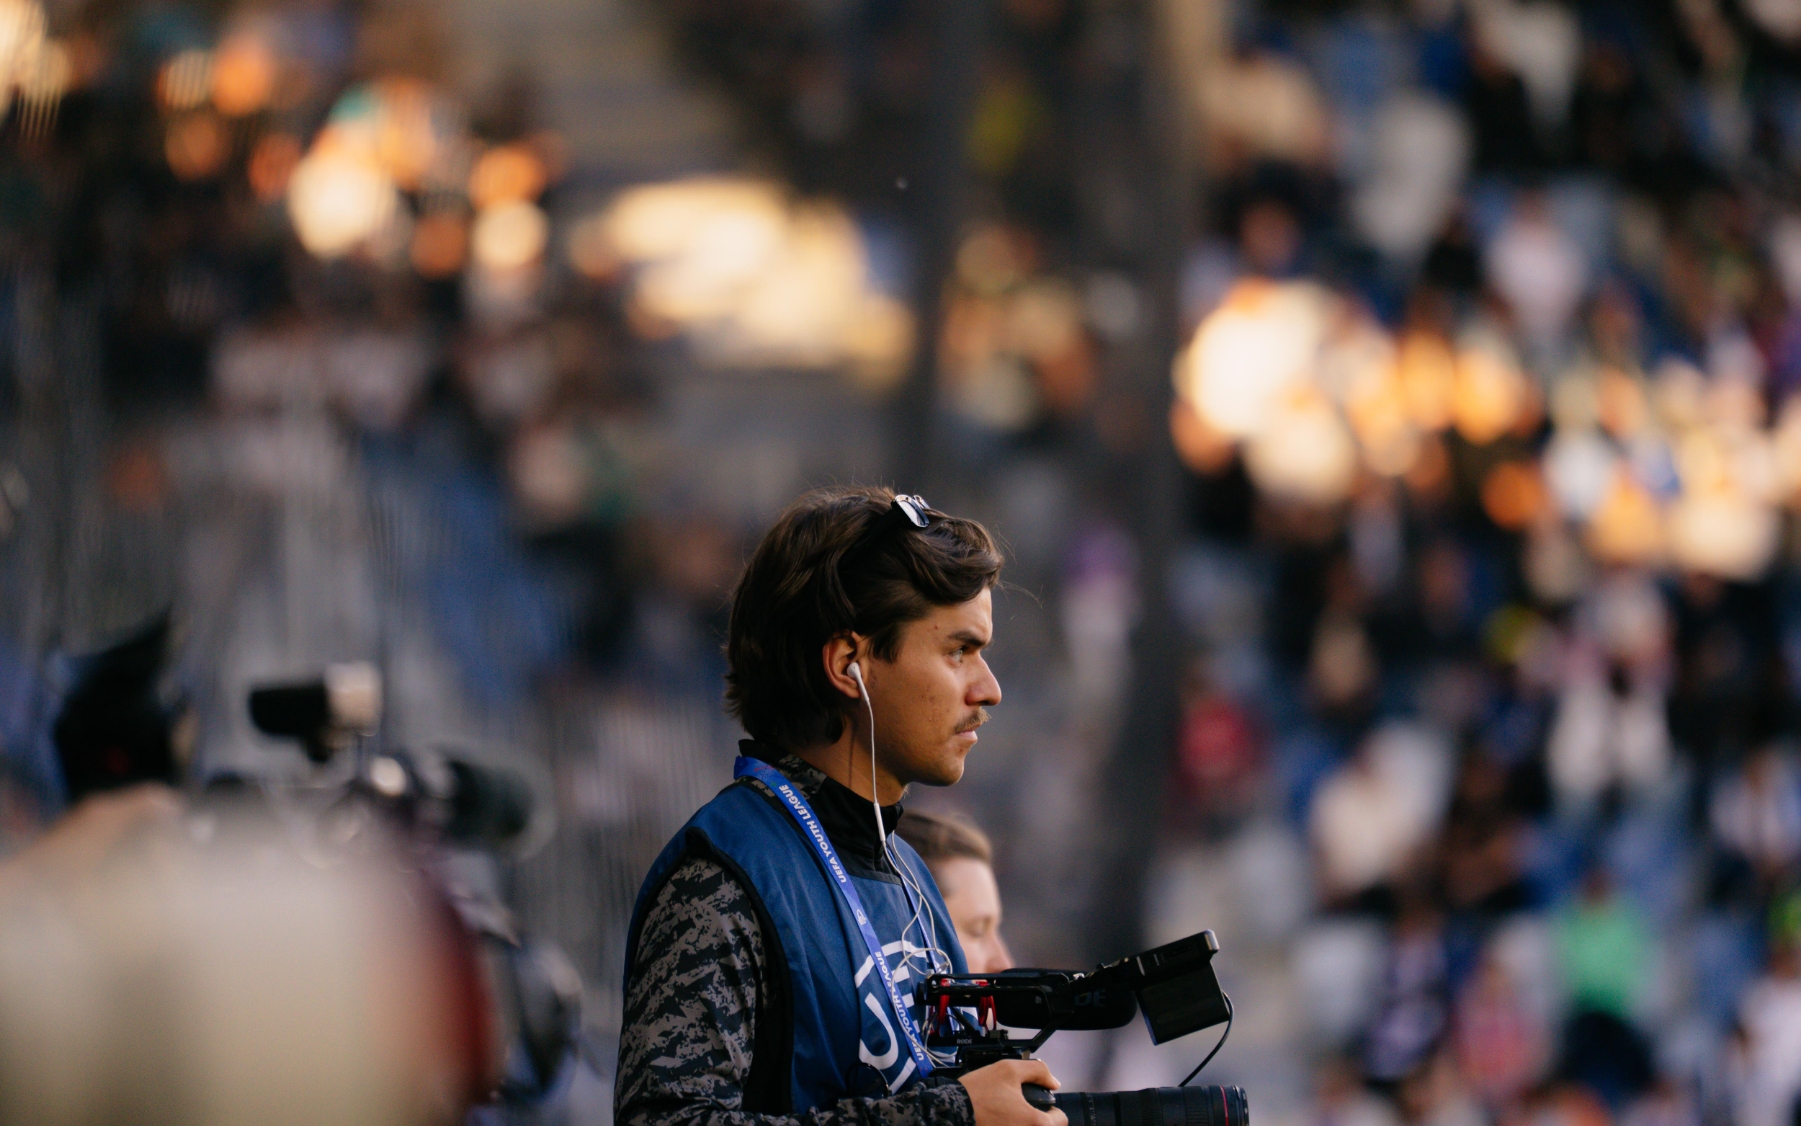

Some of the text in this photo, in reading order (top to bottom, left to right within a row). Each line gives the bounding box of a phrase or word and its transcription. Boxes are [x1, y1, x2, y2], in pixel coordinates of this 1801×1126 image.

[779, 784, 847, 883] UEFA YOUTH LEAGUE
[893, 994, 912, 1032] YOUTH
